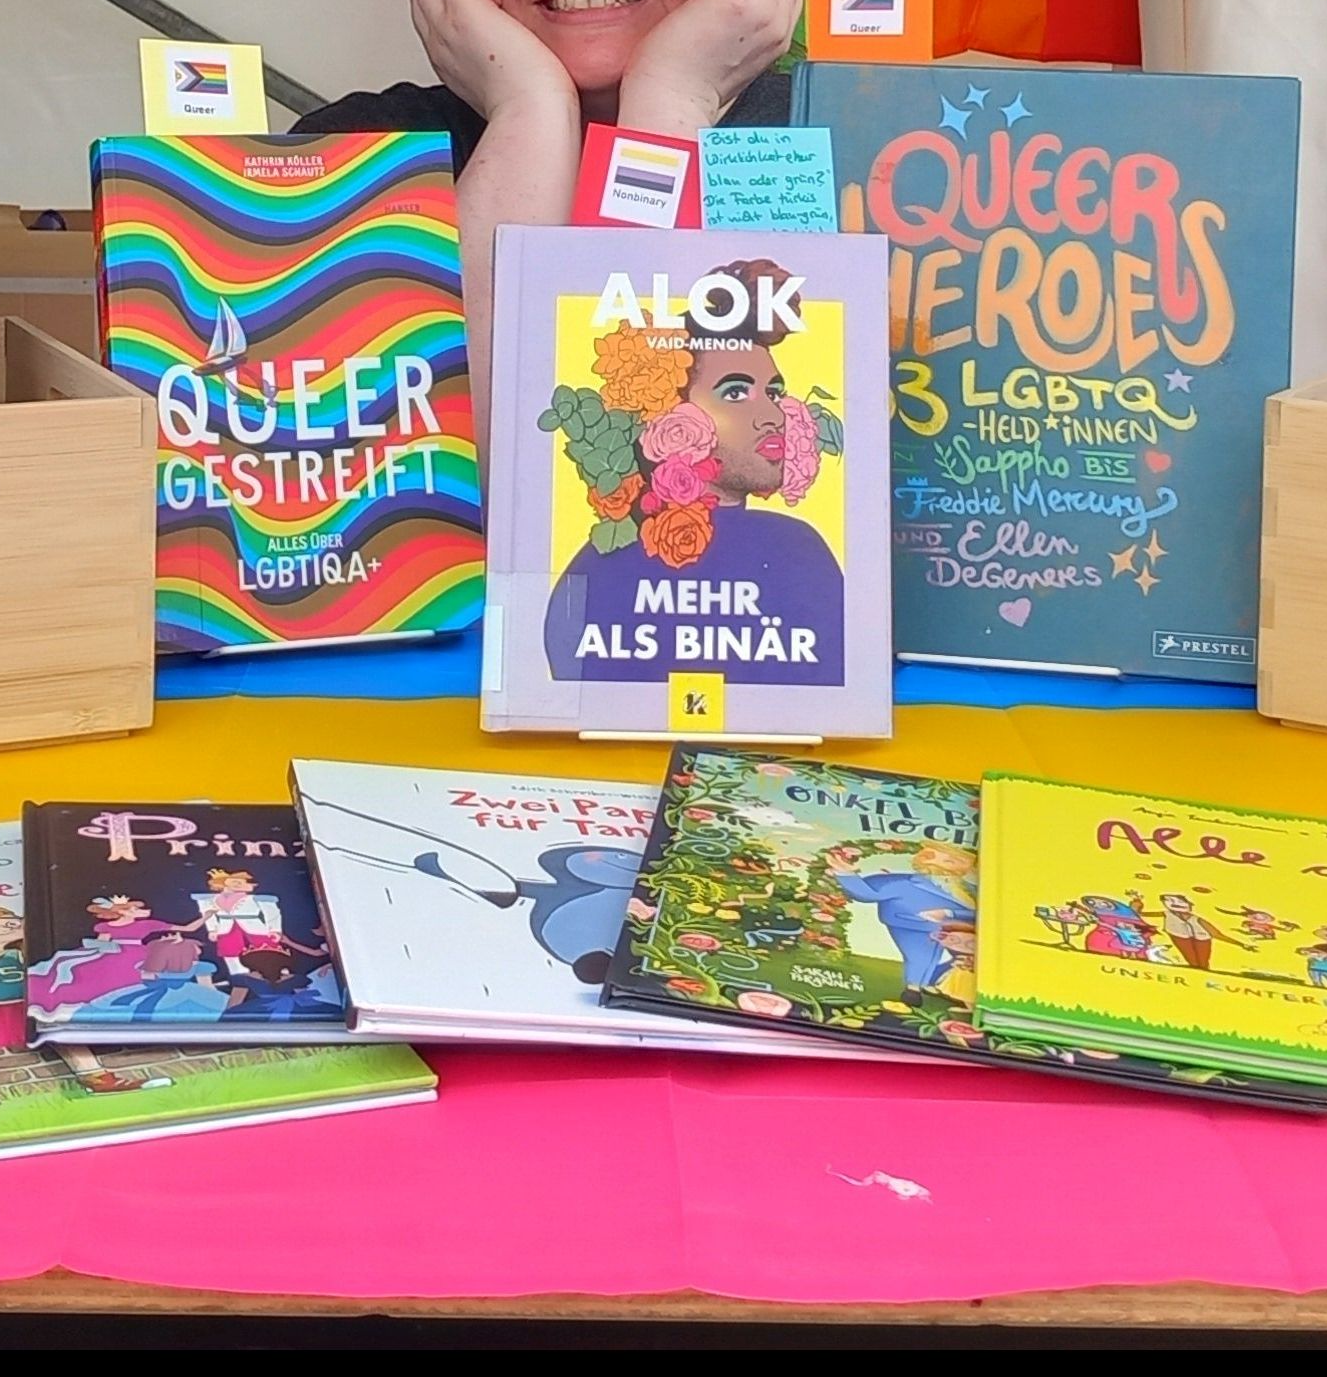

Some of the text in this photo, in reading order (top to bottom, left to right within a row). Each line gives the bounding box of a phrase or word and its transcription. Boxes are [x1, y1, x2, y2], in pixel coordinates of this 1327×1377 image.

[850, 24, 881, 33] Queer
[184, 104, 215, 114] Queer
[747, 133, 791, 145] du in
[243, 166, 325, 177] IRMELA SCHAUTZ
[244, 155, 323, 166] KATHRIN KÖLLER
[707, 174, 777, 187] blau oder
[384, 203, 420, 213] HANSER
[612, 188, 667, 208] Nonbinary
[704, 196, 725, 206] Die
[733, 191, 771, 204] Farbe
[868, 130, 1198, 321] QUEER
[590, 272, 809, 333] ALOK
[646, 335, 753, 352] VAID-MENON
[157, 356, 442, 448] QUEER
[961, 359, 1198, 431] LGBTQ
[163, 443, 442, 511] GESTREIFT
[950, 435, 1070, 496] Sappho
[893, 479, 1179, 538] Freddie Mercury
[267, 531, 343, 552] ALLES ÜBER
[957, 519, 1080, 562] Ellen
[238, 554, 382, 591] LGBTIQA+
[926, 556, 1103, 590] DeGeneres
[634, 579, 761, 617] MEHR
[575, 615, 819, 663] ALS BINÄR
[1182, 640, 1249, 657] PRESTEL
[447, 788, 561, 814] Zwei
[785, 784, 921, 820] ONKEL
[468, 811, 548, 832] für
[1096, 821, 1272, 868] Alle
[791, 964, 844, 982] SARAH
[1101, 965, 1188, 987] UNSER
